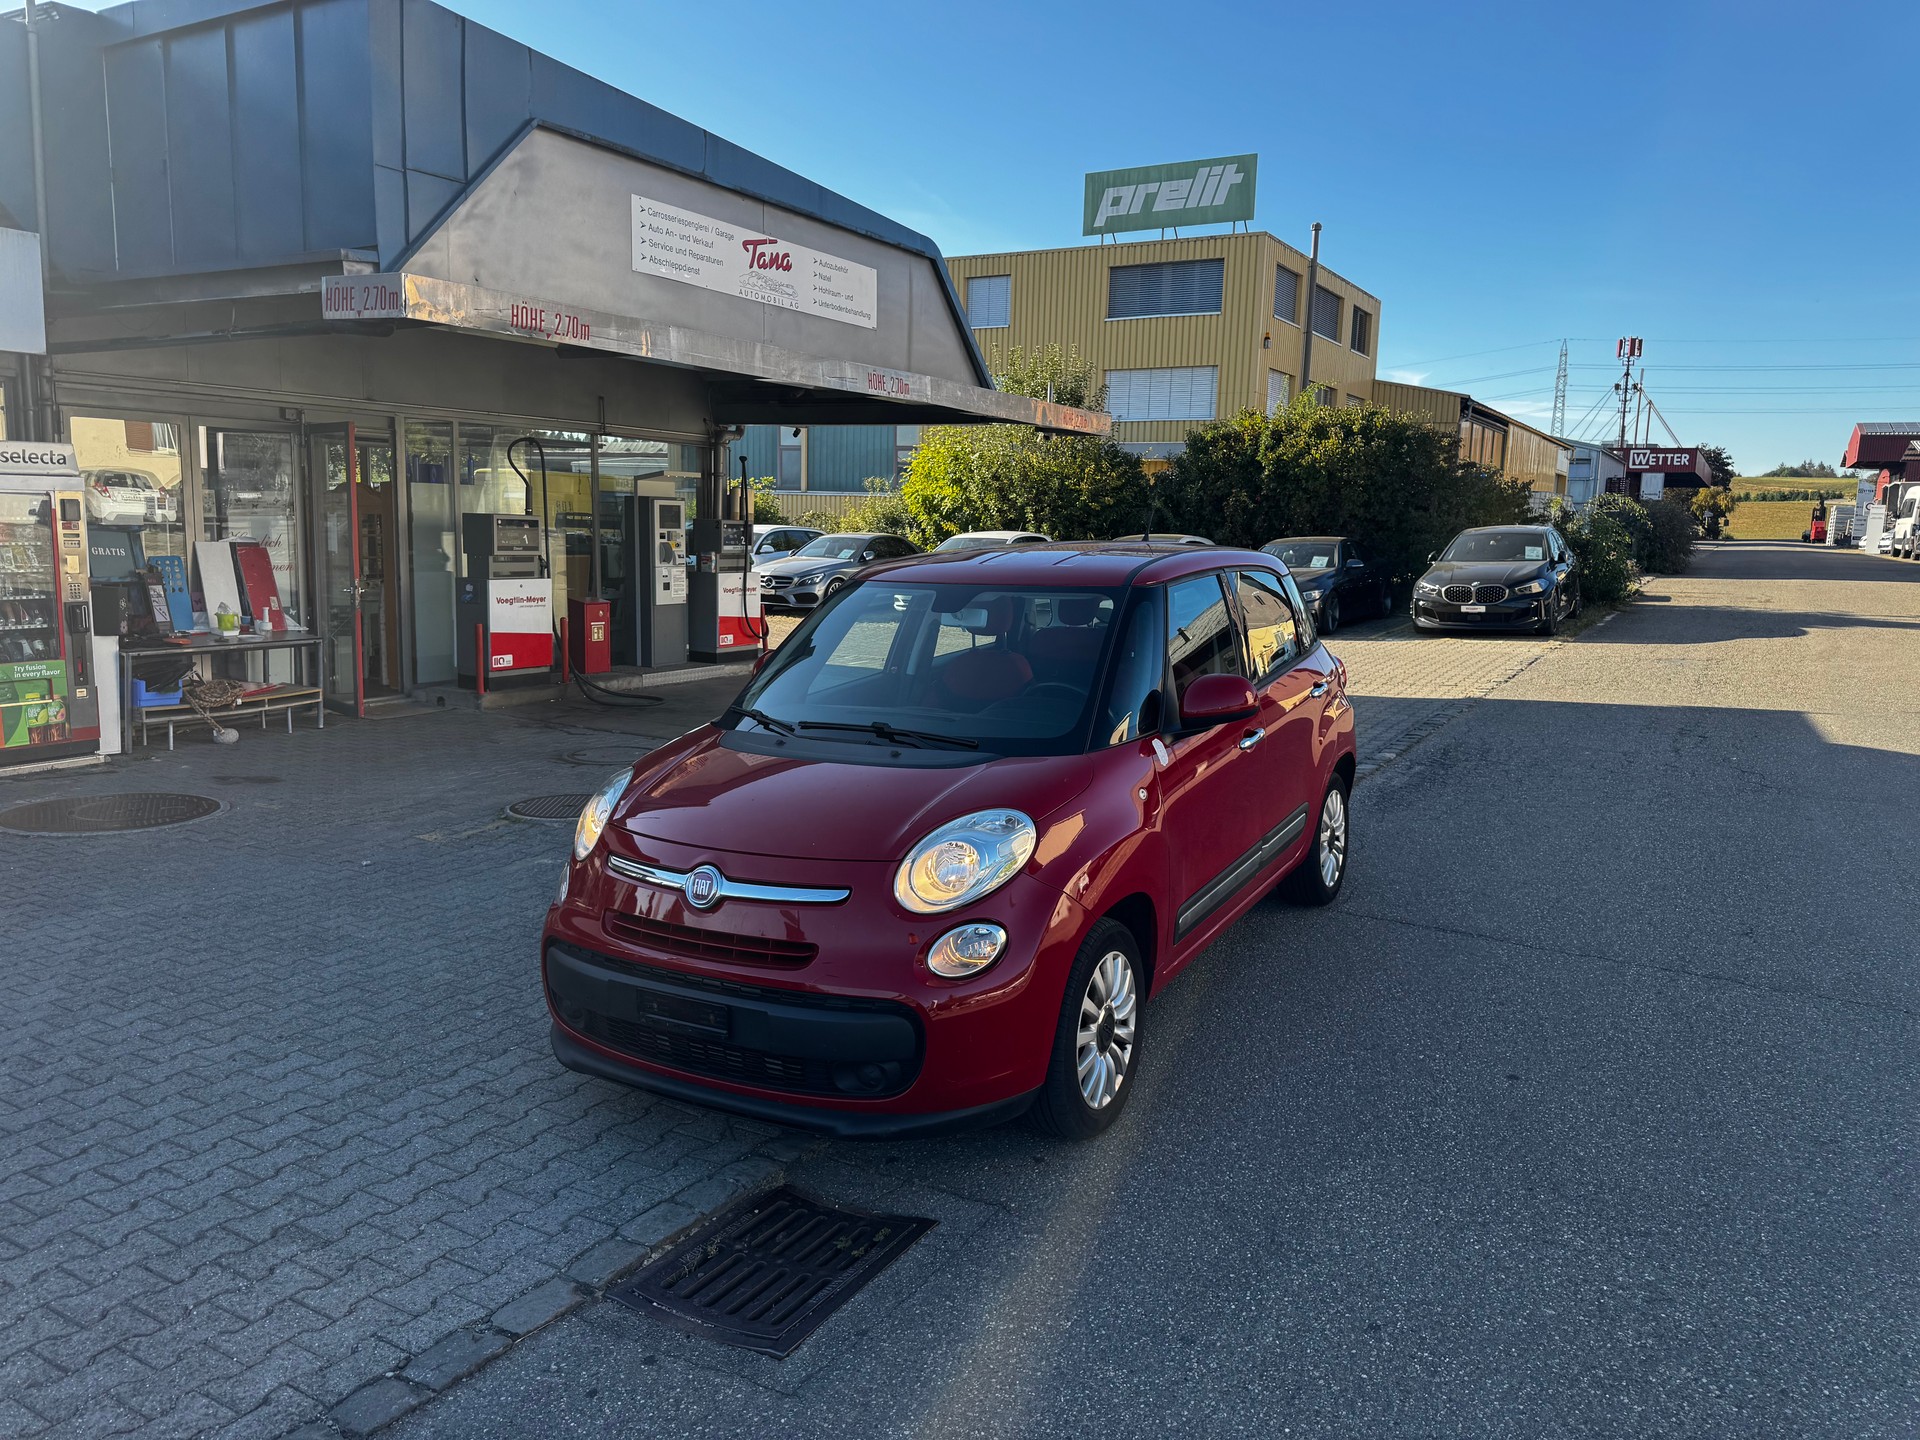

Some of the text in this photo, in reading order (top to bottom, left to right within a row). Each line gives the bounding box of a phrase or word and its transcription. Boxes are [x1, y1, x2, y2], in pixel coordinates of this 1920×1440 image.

[1093, 163, 1244, 227] prelit
[647, 207, 709, 232] Carrosseriespenglerei
[714, 227, 735, 241] Garage
[648, 223, 714, 249] Auto An- und Verkauf
[648, 238, 724, 267] Service und Reparaturen
[742, 238, 792, 272] Tana
[648, 255, 701, 275] Abschleppdienst
[818, 259, 849, 274] Autozubehör
[325, 281, 355, 312] HÖHE
[738, 288, 799, 310] AUTOMOBIL AG
[844, 293, 854, 302] und
[511, 301, 545, 332] HÖHE
[818, 299, 871, 320] Unterbodenbehandlung
[867, 369, 886, 391] HÖHE
[0, 449, 67, 465] selecta
[1630, 450, 1690, 468] WETTER
[91, 547, 126, 557] GRATIS
[14, 663, 46, 673] Try fusion
[22, 670, 40, 678] every
[41, 669, 60, 677] flavor
[693, 878, 711, 896] FIAT
